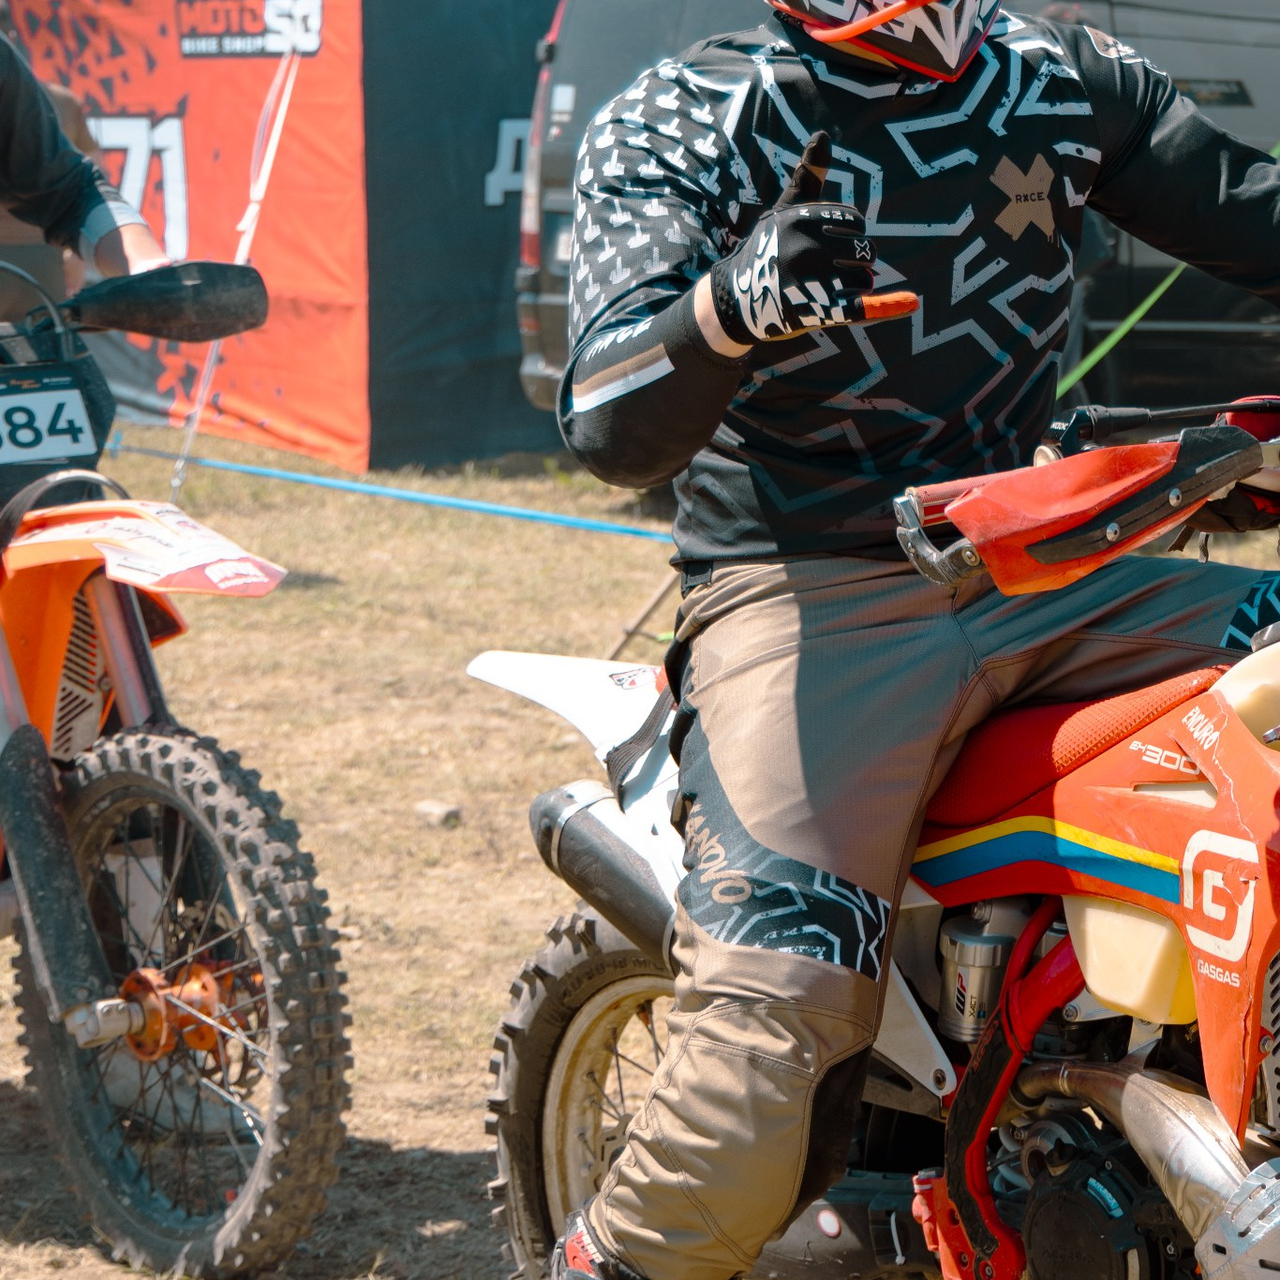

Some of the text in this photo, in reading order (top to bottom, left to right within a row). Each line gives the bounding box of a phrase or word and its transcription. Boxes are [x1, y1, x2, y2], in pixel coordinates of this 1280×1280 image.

[0, 401, 84, 450] 84
[1181, 705, 1220, 751] ENDURO
[1197, 959, 1241, 989] GASGAS
[968, 994, 978, 1019] XACT
